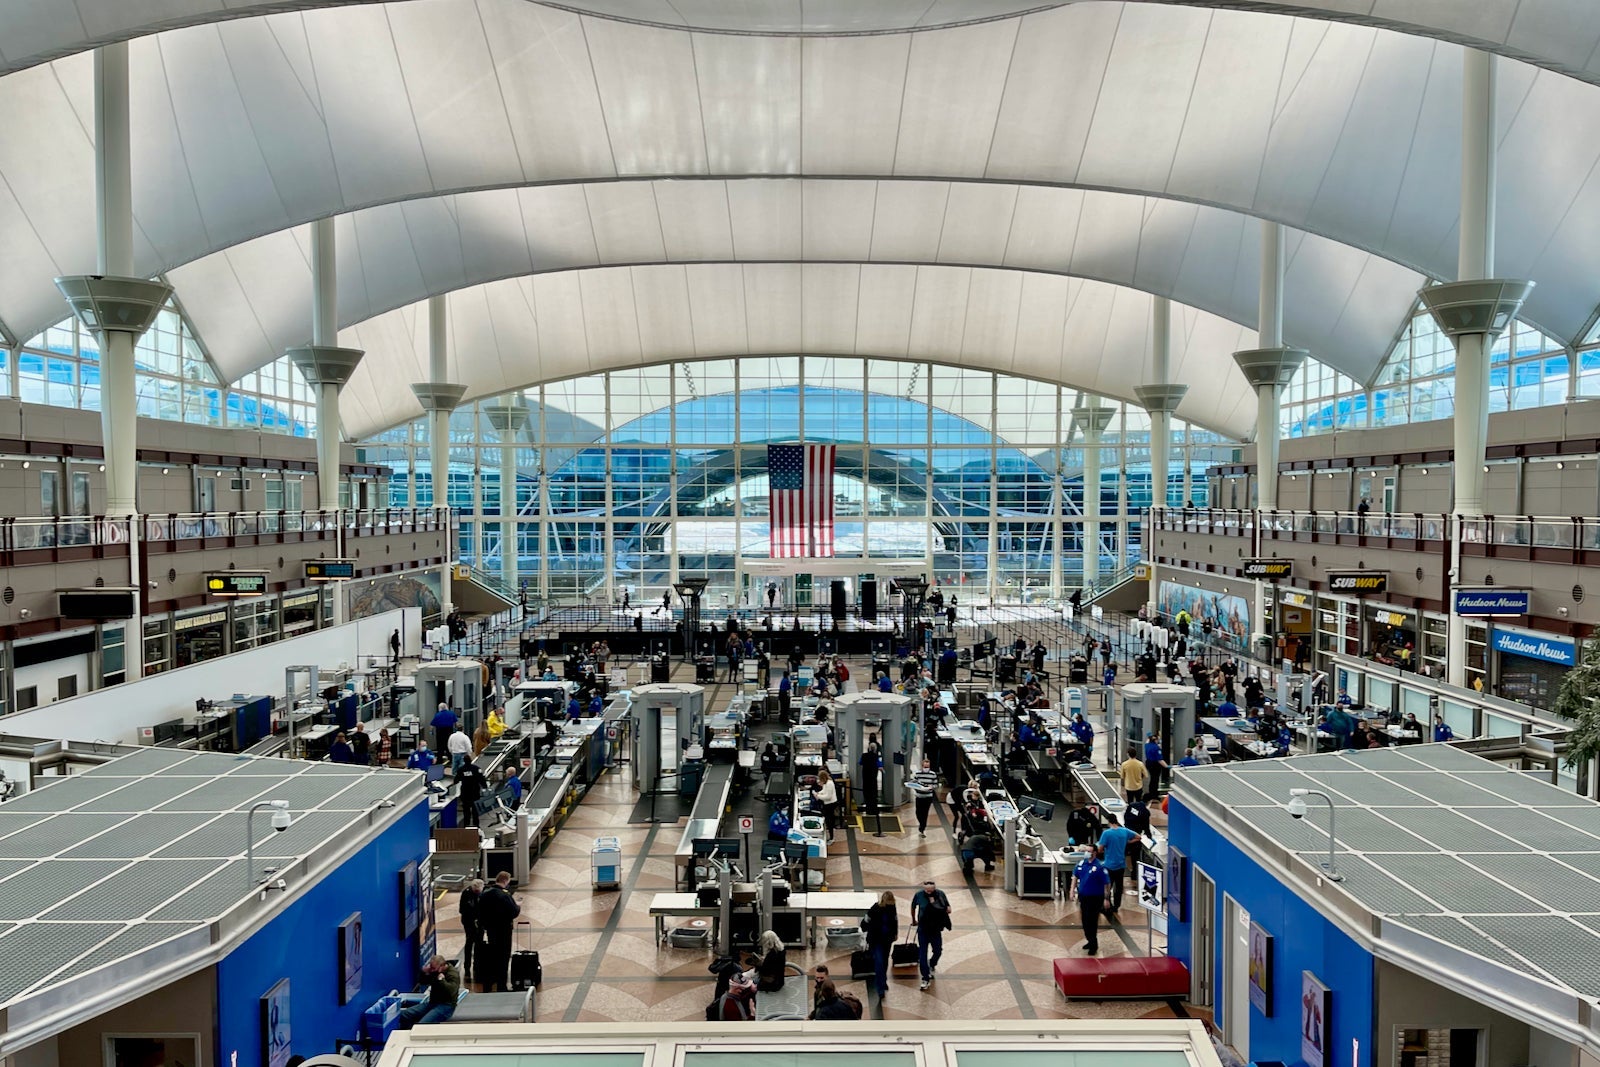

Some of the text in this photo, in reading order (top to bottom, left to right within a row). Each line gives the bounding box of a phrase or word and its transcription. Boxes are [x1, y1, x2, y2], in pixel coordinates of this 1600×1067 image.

[1246, 564, 1290, 574] SUBWAY
[1331, 577, 1385, 588] SUBWAY
[1285, 593, 1306, 604] SUBWAY
[1459, 597, 1526, 607] Hudson News
[1375, 610, 1406, 626] SUBWAY
[1498, 635, 1570, 660] Hudson News
